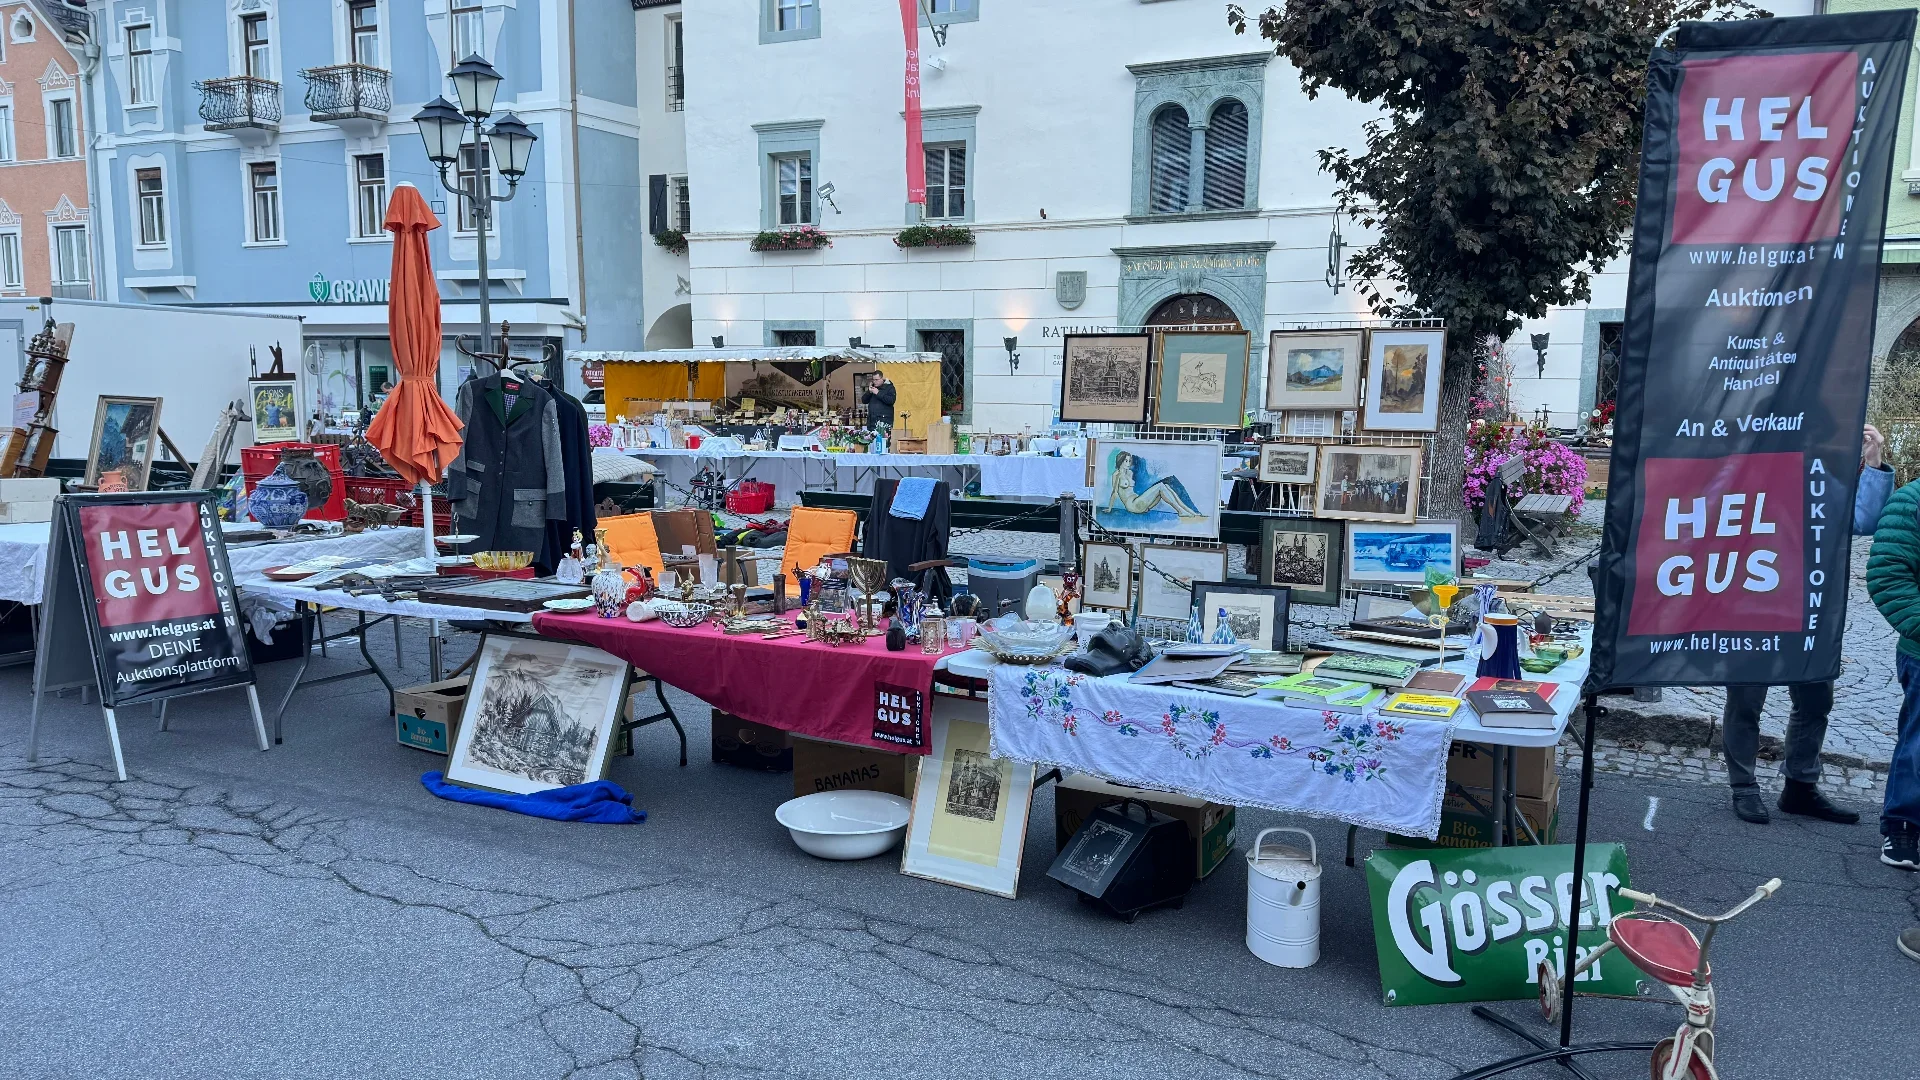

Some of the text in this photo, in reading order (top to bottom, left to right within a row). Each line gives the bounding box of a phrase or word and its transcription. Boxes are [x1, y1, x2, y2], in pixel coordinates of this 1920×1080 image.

[1702, 95, 1828, 141] HEL
[1833, 57, 1876, 260] AUKTIONEN
[1697, 156, 1830, 204] GUS
[1689, 245, 1815, 268] www.helgus.at
[1705, 284, 1813, 307] Auktionen
[1727, 331, 1785, 350] Kunst &
[1708, 351, 1797, 373] Antiquitäten
[1723, 370, 1780, 391] Handel
[1676, 411, 1805, 437] An & Verkauf
[1664, 492, 1776, 540] HEL
[100, 527, 191, 561] HEL
[1803, 458, 1826, 652] AUKTIONEN
[200, 503, 235, 628] AUKTIONEN
[1656, 549, 1780, 597] GUS
[104, 563, 201, 599] GUS
[109, 617, 217, 643] www.helgus.at
[148, 637, 203, 659] DEINE
[1650, 633, 1781, 654] www.helgus.at
[116, 654, 240, 684] Auktionsplattform
[879, 691, 911, 711] HEL
[877, 707, 912, 726] GUS
[814, 763, 880, 792] BANANAS
[1432, 834, 1493, 848] anane
[1452, 821, 1482, 836] Bio-
[1387, 859, 1621, 982] Gösser
